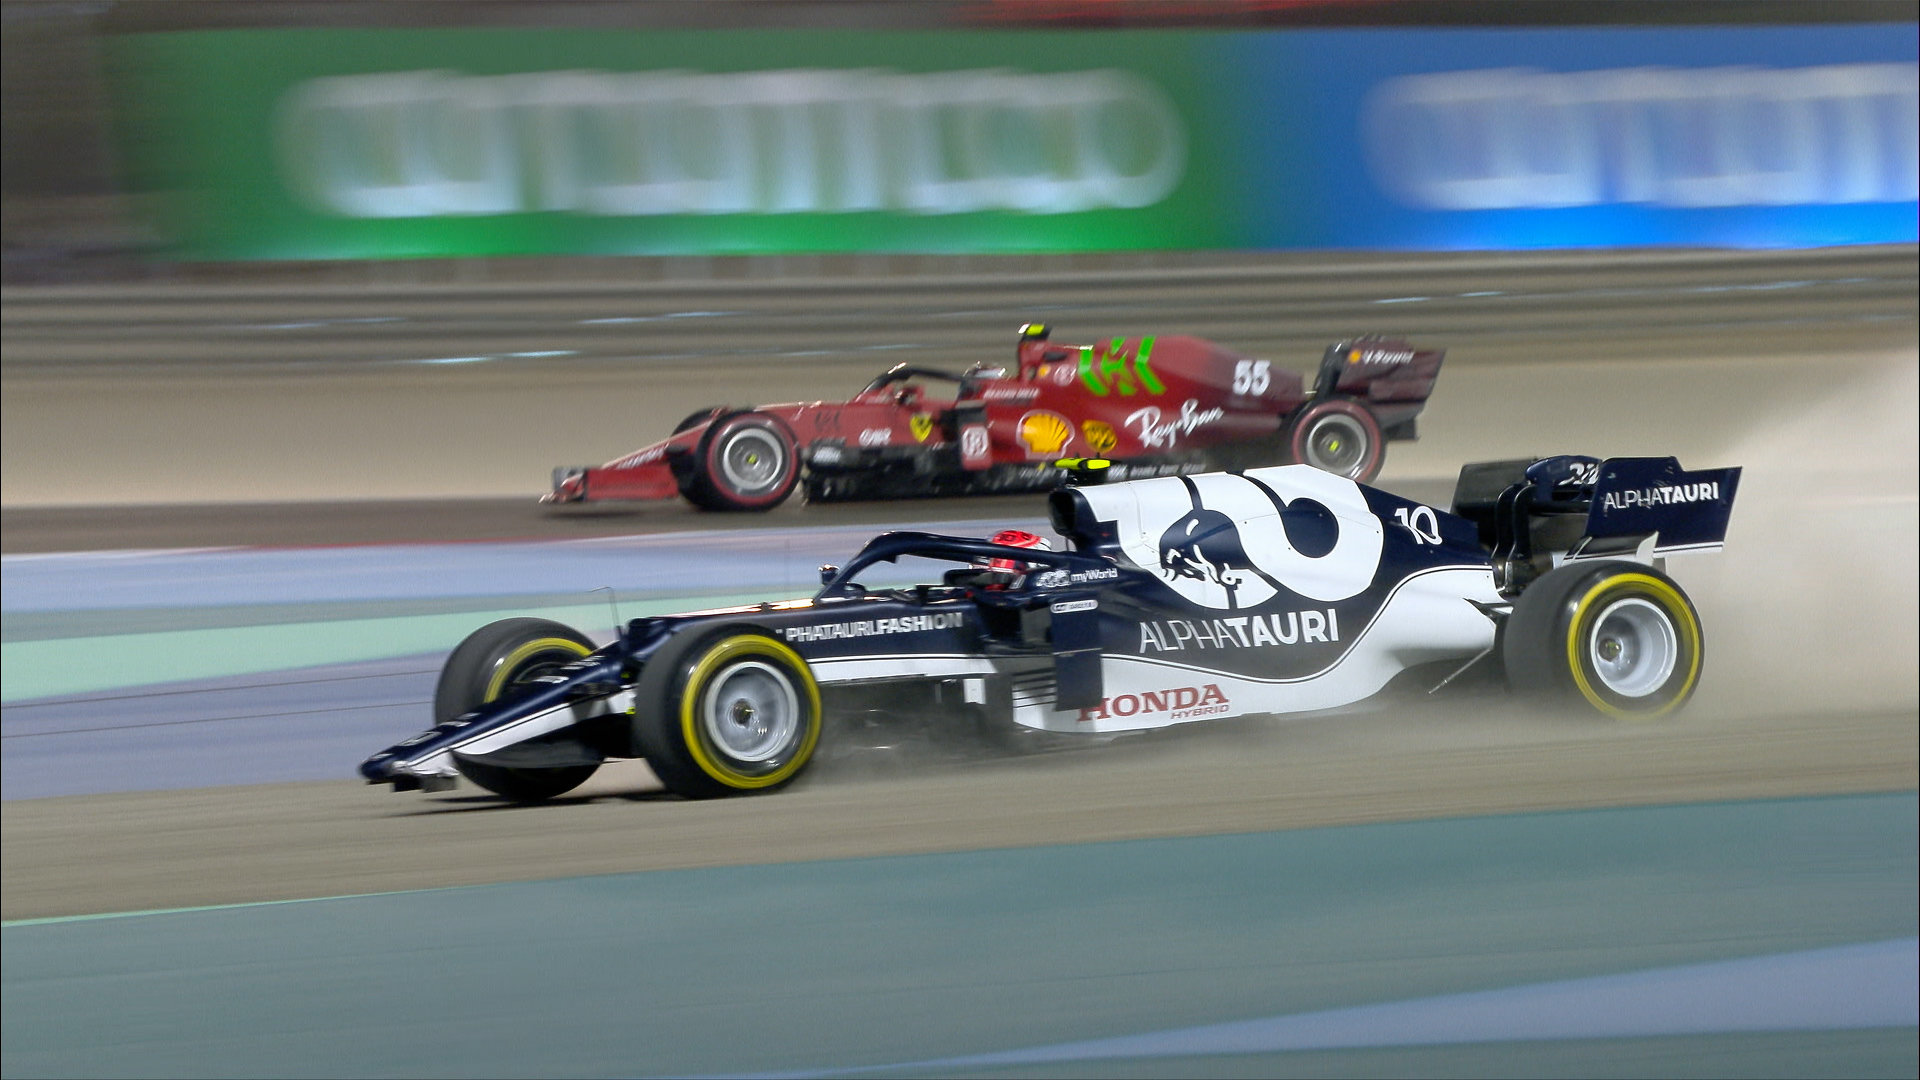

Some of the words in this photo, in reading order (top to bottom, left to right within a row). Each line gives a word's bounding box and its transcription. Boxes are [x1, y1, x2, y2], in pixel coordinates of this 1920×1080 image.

[1233, 360, 1271, 396] 55
[1124, 398, 1225, 448] Ray-Ban
[1603, 481, 1719, 511] ALPHATAURI
[1394, 506, 1443, 545] 10
[1070, 568, 1118, 582] myWorld
[1139, 608, 1339, 653] ALPHATAURI
[1077, 684, 1229, 722] HONDA
[1171, 704, 1229, 719] HYBRID
